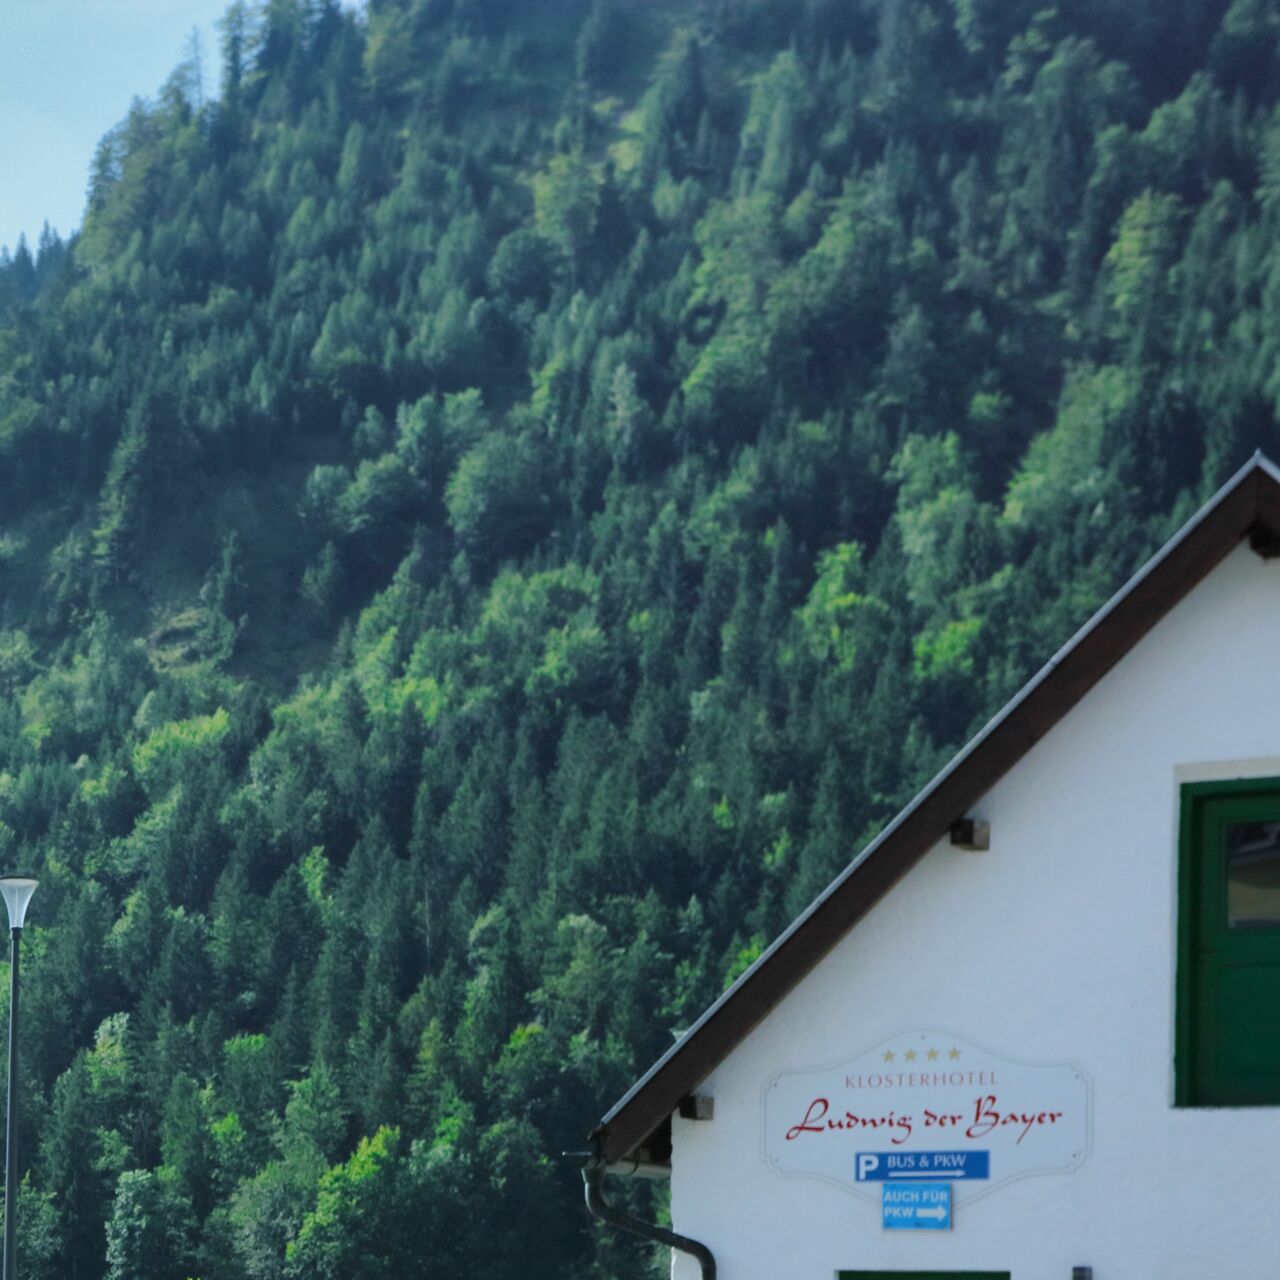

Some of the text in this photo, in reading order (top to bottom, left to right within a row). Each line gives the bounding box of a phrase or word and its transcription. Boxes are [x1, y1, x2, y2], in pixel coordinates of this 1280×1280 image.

[845, 1071, 1000, 1089] KLOSTERHOTEL
[785, 1094, 1064, 1145] Ludwig der Bayer
[859, 1153, 967, 1180] P BUS & PKW
[883, 1188, 948, 1204] AUCH FÜR
[884, 1206, 914, 1219] PKW
